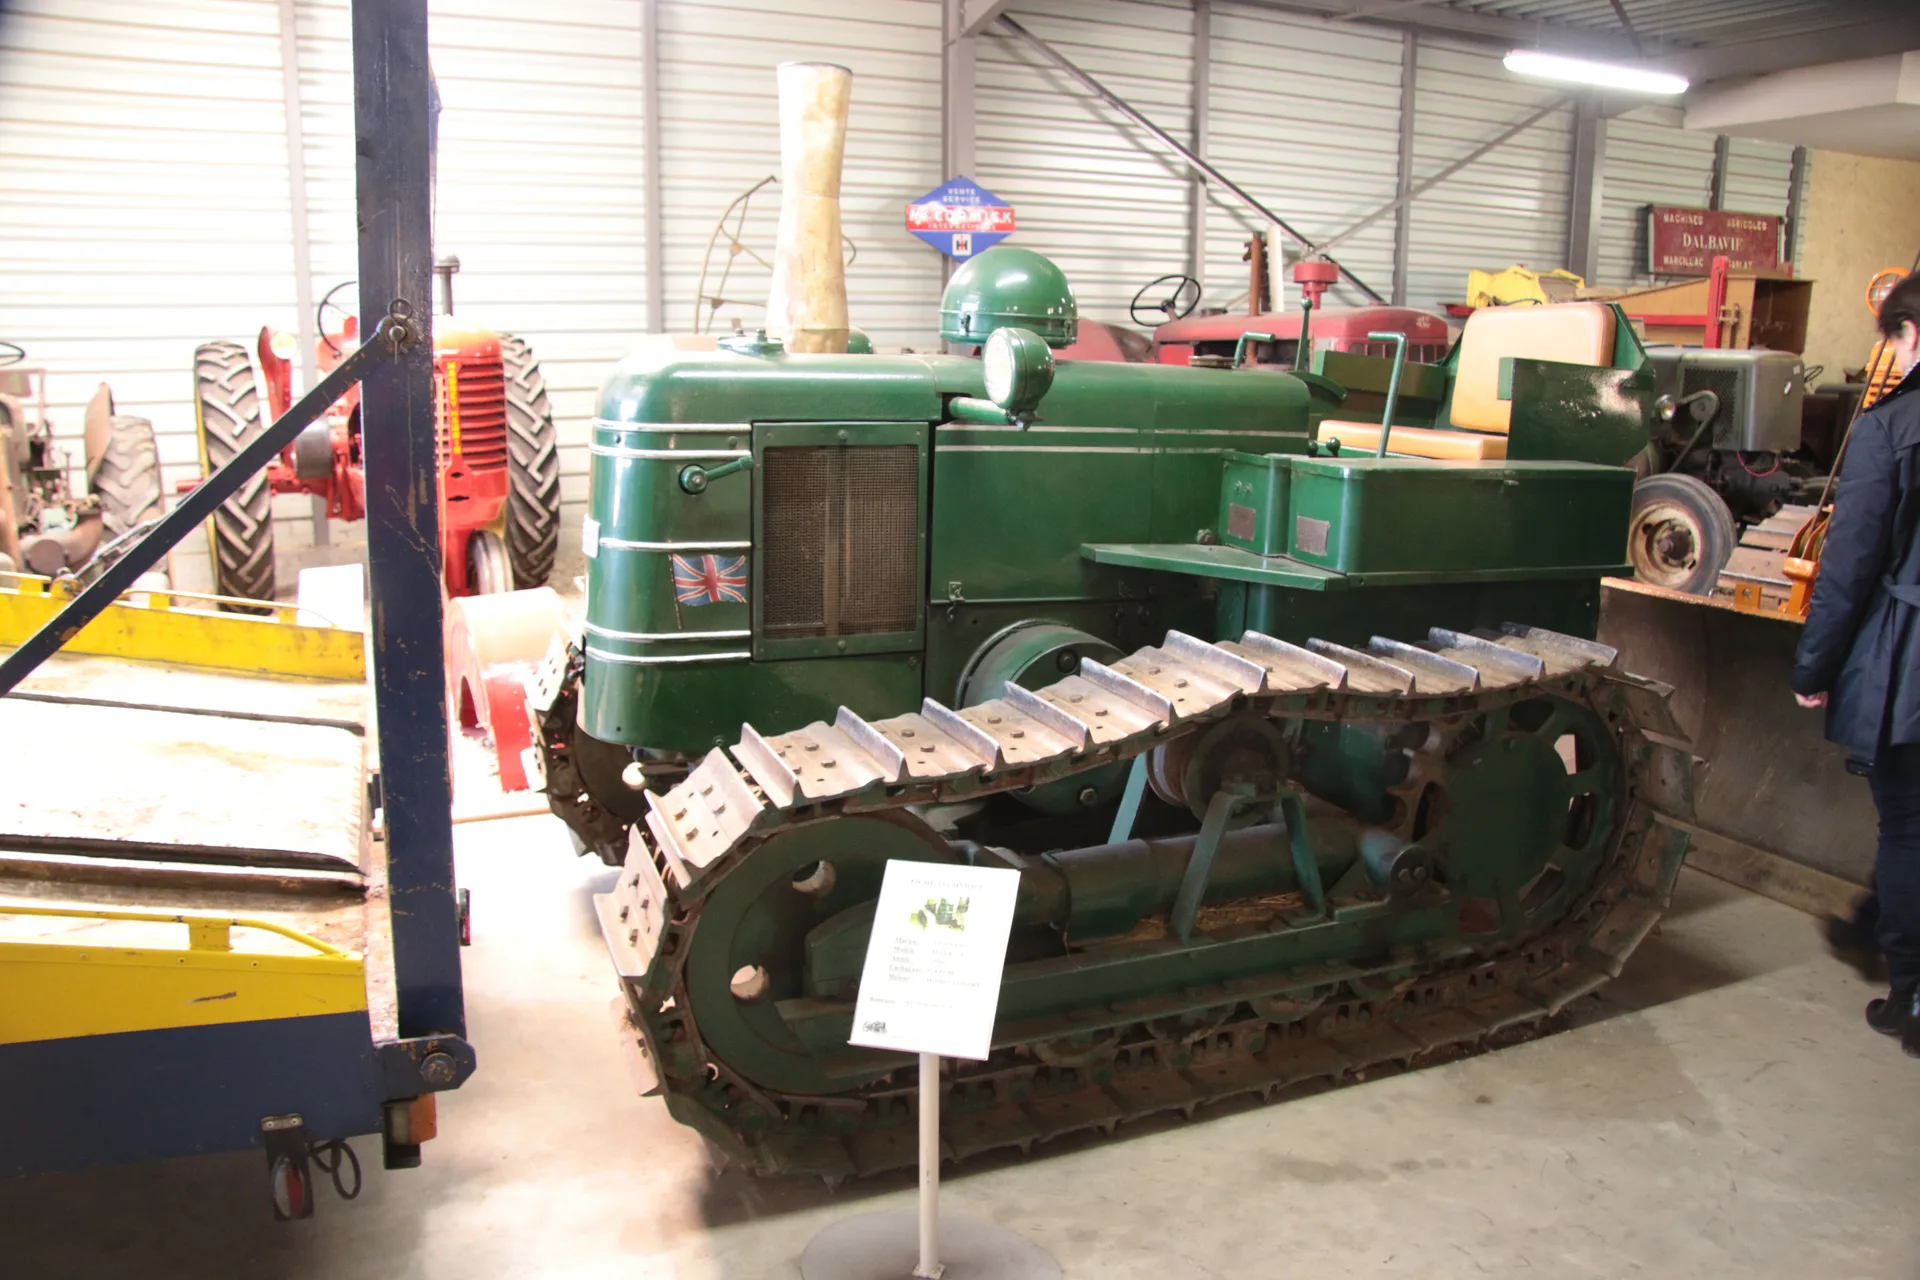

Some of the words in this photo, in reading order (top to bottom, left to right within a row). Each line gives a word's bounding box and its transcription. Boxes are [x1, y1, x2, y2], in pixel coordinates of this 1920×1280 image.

[943, 196, 980, 204] SERVICE
[1663, 213, 1704, 226] MACHINES
[1727, 218, 1767, 231] AGRICOLES
[1682, 232, 1744, 251] DALBAVIE
[1663, 255, 1704, 268] MARCILLAC
